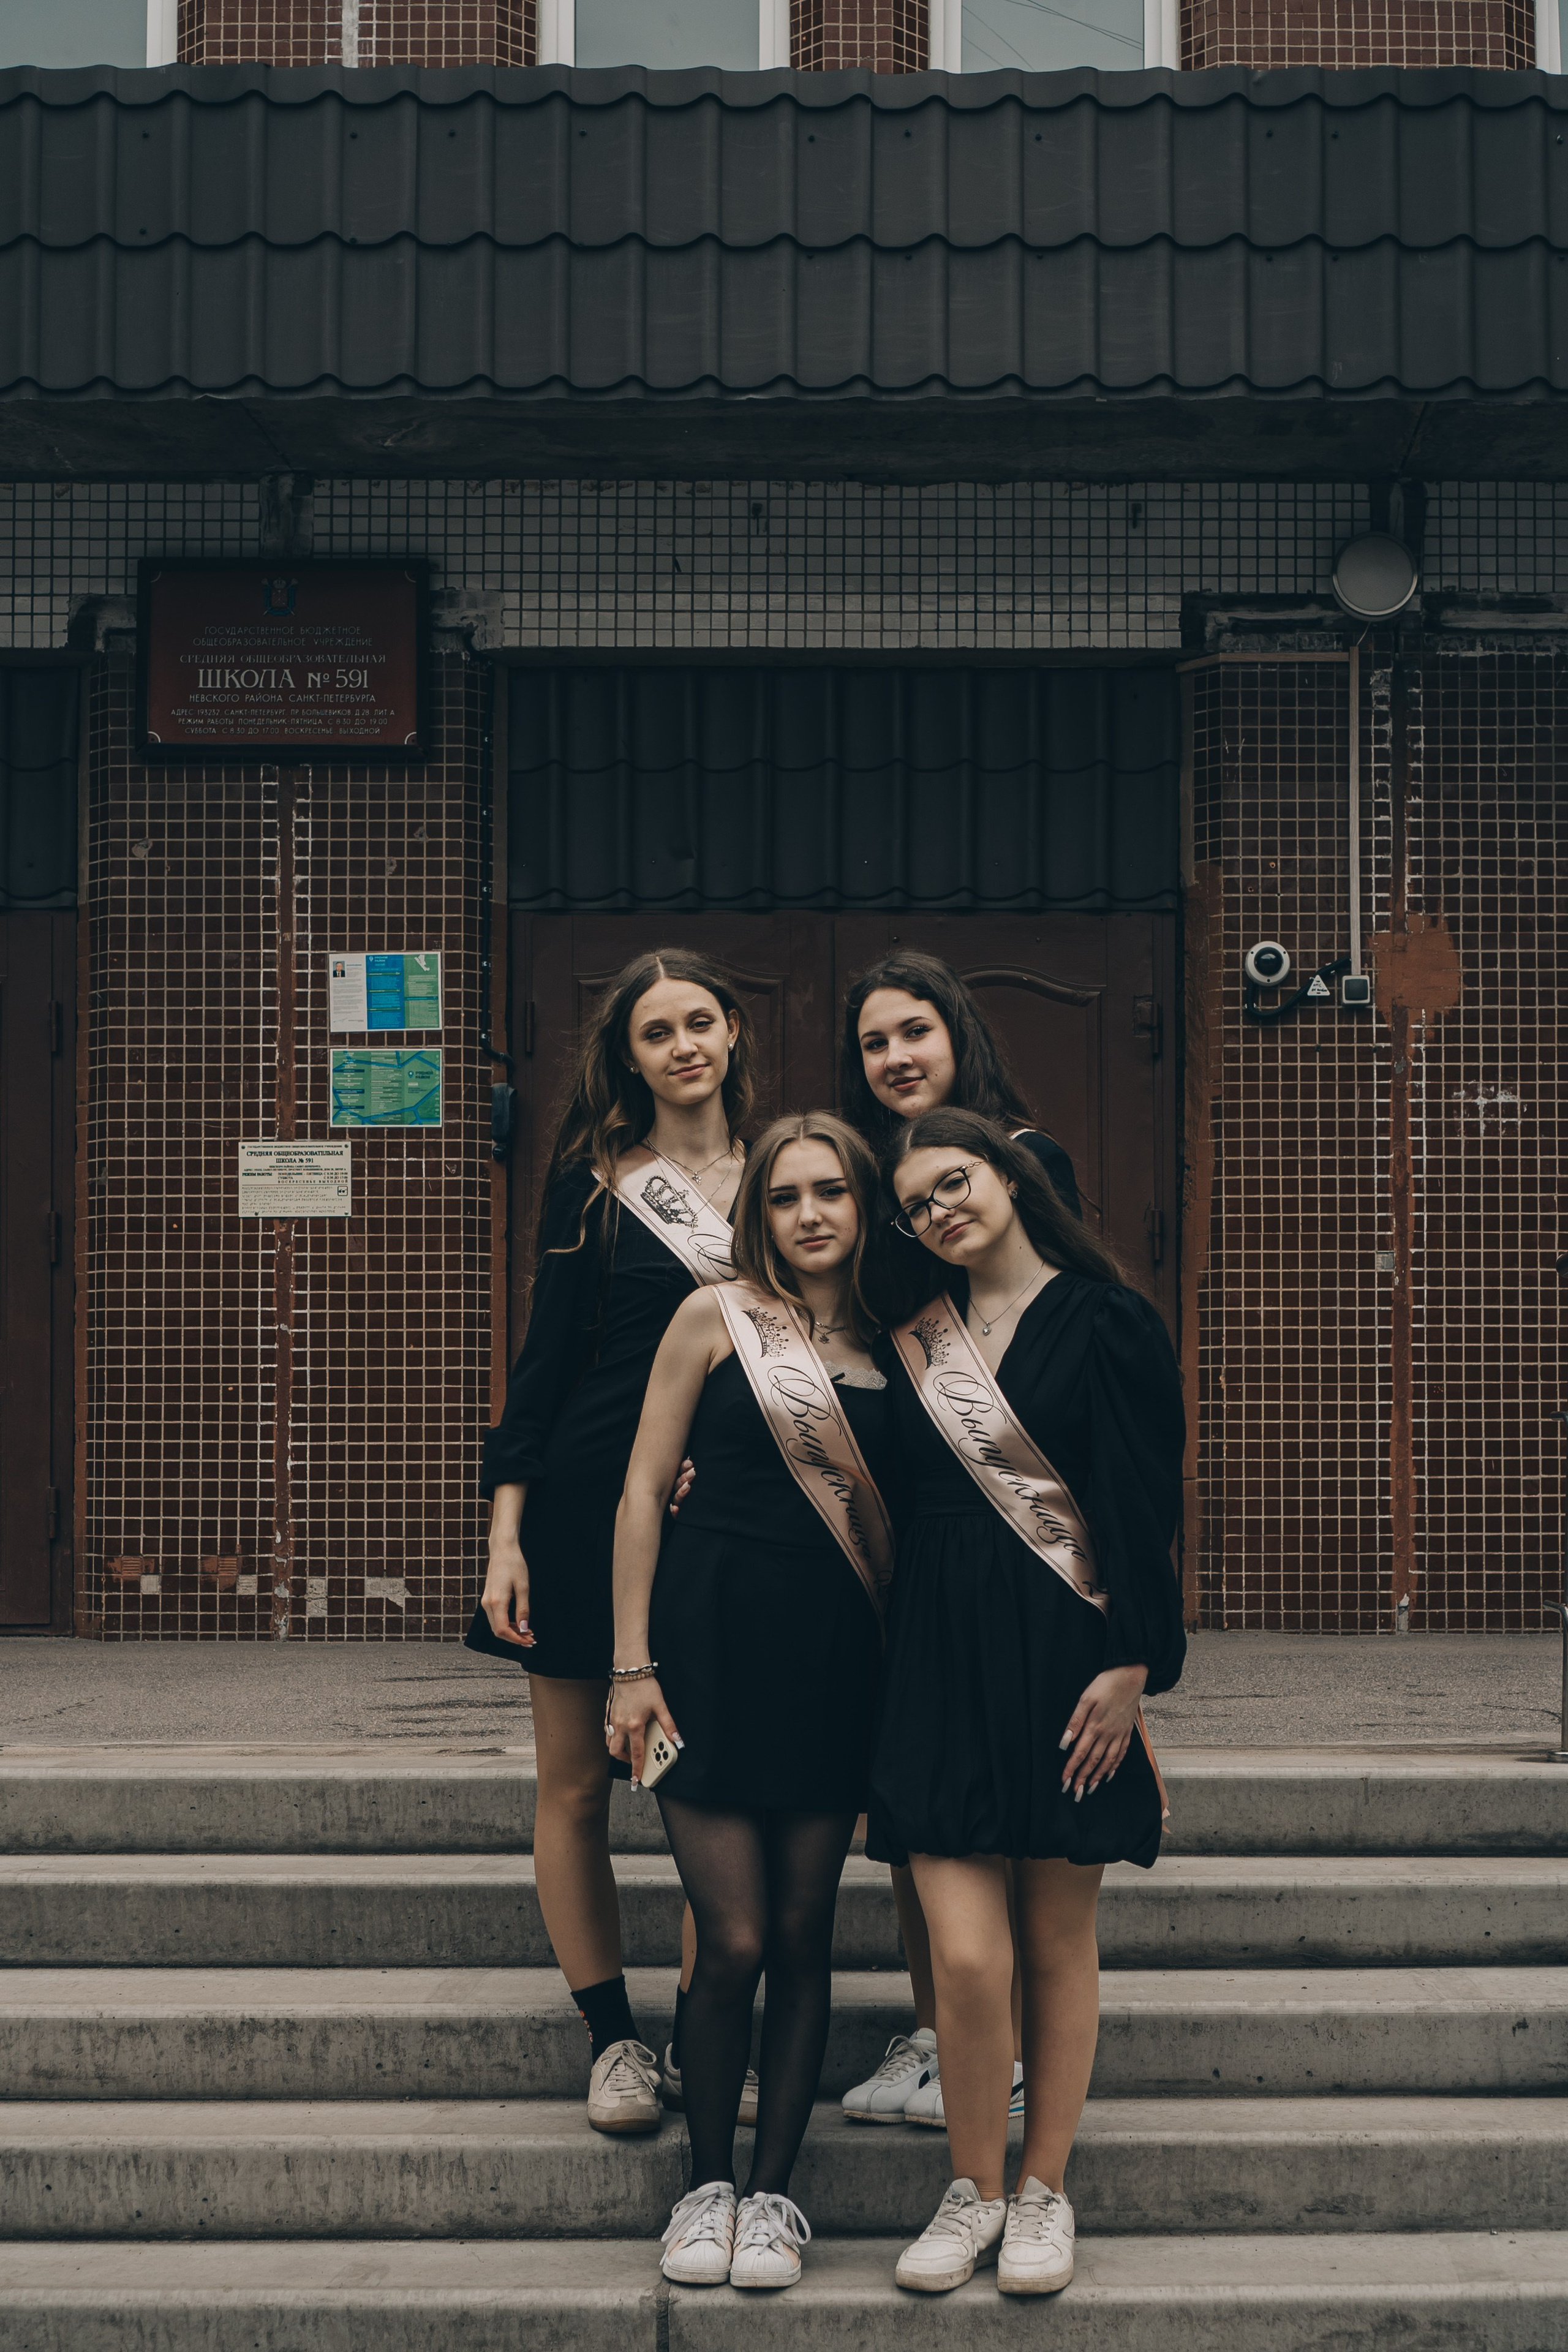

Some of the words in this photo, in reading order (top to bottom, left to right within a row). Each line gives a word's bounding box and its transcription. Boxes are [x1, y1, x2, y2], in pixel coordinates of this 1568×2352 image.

[205, 626, 294, 635] ГОСУДАРСТВЕННОЕ
[300, 626, 361, 635] БЮДЖЕТНОЕ
[193, 638, 306, 647] ОБЩЕОБРАЗОВАТЕЛЬНОЕ
[313, 638, 373, 646] УЧРЕЖДЕНИЕ
[179, 654, 235, 664] СРЕДНЯЯ
[240, 654, 386, 664] ОБЩЕОБРАЗОВАТЕЛЬНАЯ
[197, 668, 296, 688] ШКОЛА
[336, 668, 369, 688] 591
[189, 694, 239, 703] НЕВСКОГО
[245, 693, 283, 703] РАЙОНА
[288, 694, 376, 703] САНКТ-ПЕТЕРБУРГА
[933, 1371, 1088, 1562] Выпускница
